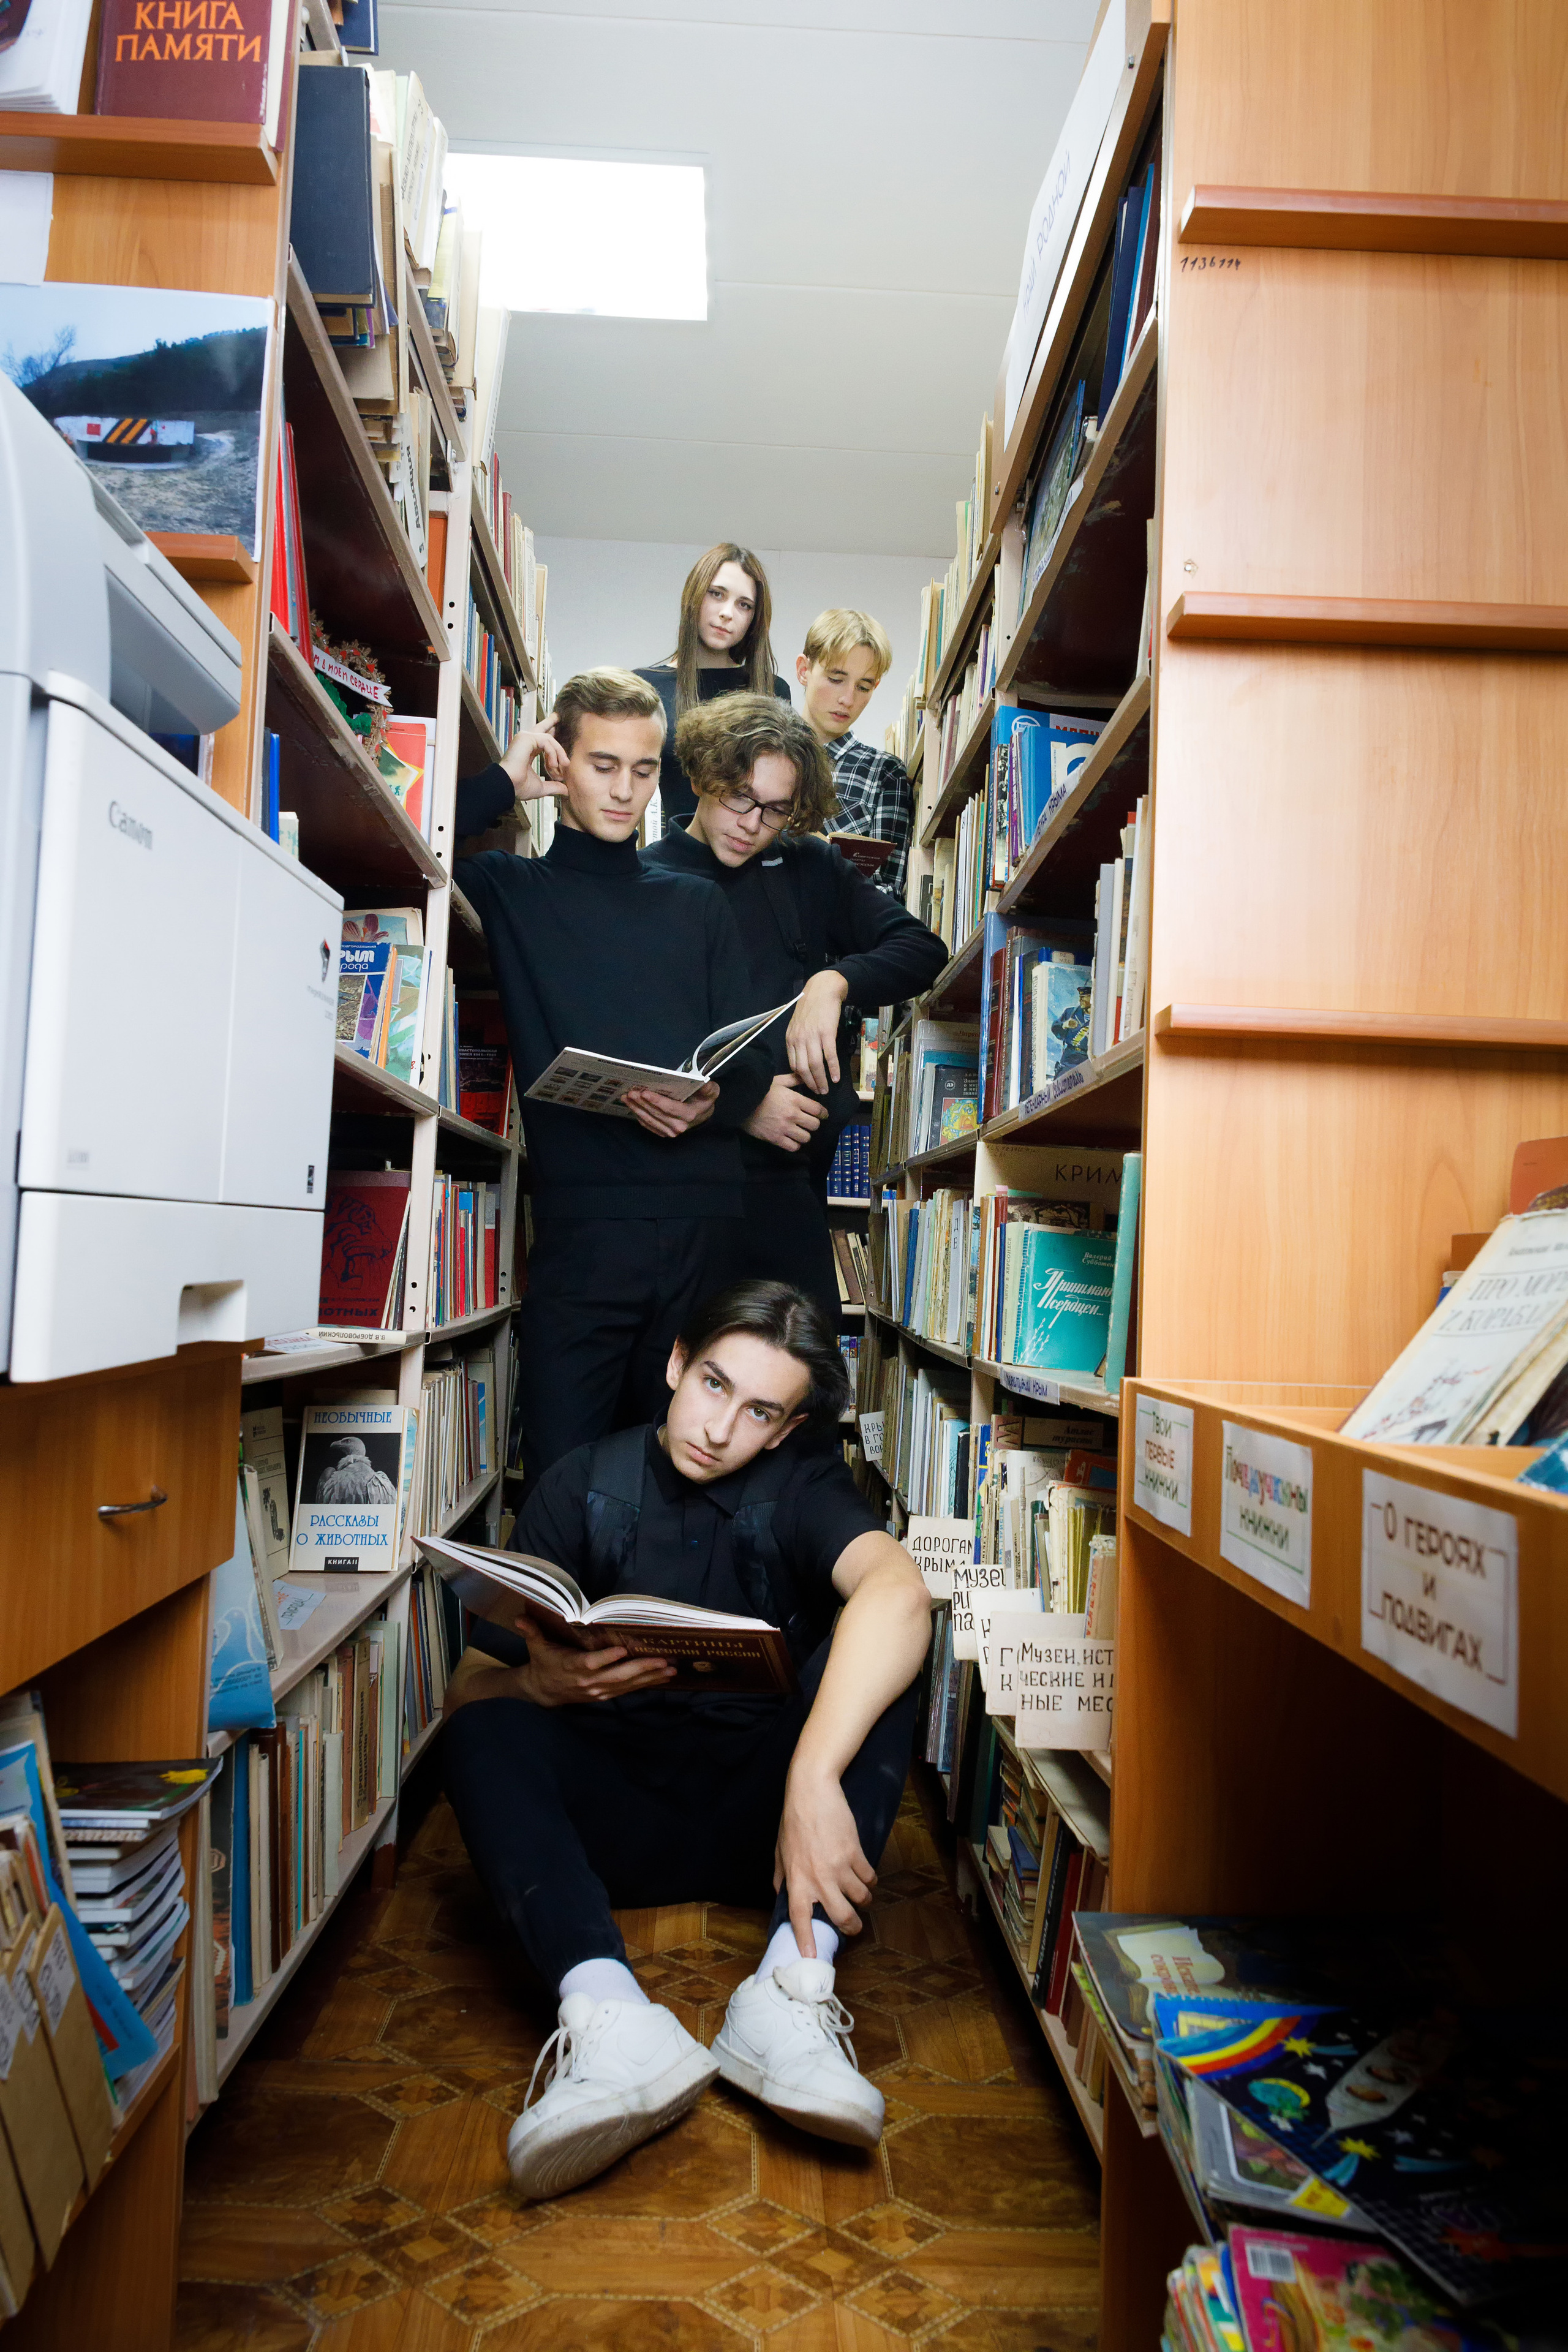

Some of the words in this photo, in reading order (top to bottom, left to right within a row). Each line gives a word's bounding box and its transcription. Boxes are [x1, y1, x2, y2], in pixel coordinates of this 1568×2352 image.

[134, 1, 244, 31] КНИГА
[115, 33, 262, 62] ПАМЯТИ
[1036, 149, 1071, 261] РОДНОЙ
[108, 799, 153, 851] Canon
[1084, 1251, 1112, 1261] Валерий
[318, 1331, 374, 1340] ДОБРОВОЛЬСКИЙ
[313, 1411, 393, 1424] НЕОБЫЧНЫЕ
[864, 1421, 885, 1433] КРЫ
[873, 1432, 884, 1443] ГО
[1145, 1439, 1175, 1469] ПЕРВЫЕ
[1144, 1468, 1178, 1502] КНИЖКИ
[309, 1514, 380, 1528] РАССКАЗЫ
[1238, 1504, 1290, 1552] КНИЖКИ
[296, 1532, 309, 1545] О
[314, 1533, 389, 1546] ЖИВОТНЫХ
[1383, 1500, 1398, 1542] О
[1404, 1515, 1488, 1580] ГЕРОЯХ
[1422, 1570, 1438, 1602] И
[1381, 1590, 1483, 1673] ПОДВИГАХ
[634, 1646, 700, 1656] ИСТОРИИ
[643, 1637, 744, 1648] КАРТИНЫ
[1019, 1670, 1085, 1687] ЧЕСКИЕ
[1020, 1694, 1063, 1711] НЫЕ
